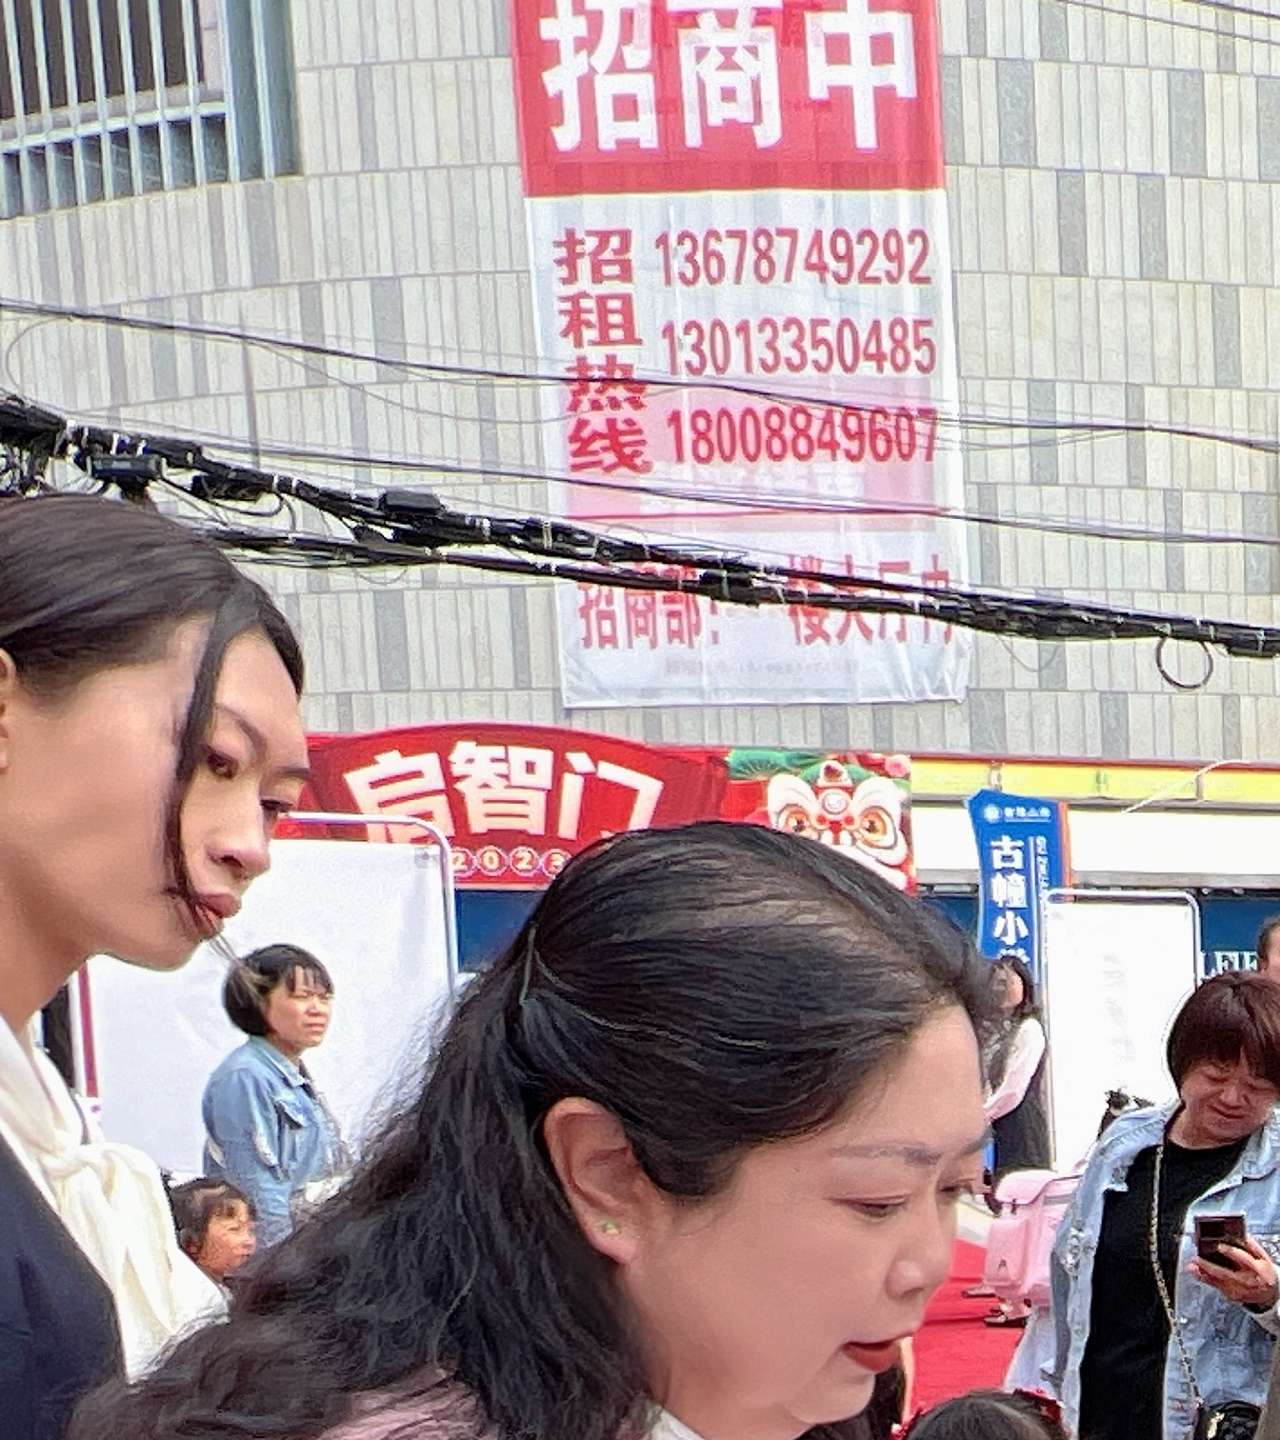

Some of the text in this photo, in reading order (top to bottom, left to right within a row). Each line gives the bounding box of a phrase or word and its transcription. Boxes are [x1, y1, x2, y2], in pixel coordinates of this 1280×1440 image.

[540, 0, 918, 152] 招商中
[655, 226, 933, 288] 13678749292
[553, 228, 653, 475] 招租热线
[662, 316, 938, 376] 13013350485
[667, 404, 940, 464] 18008849607
[343, 740, 664, 844] 启智门
